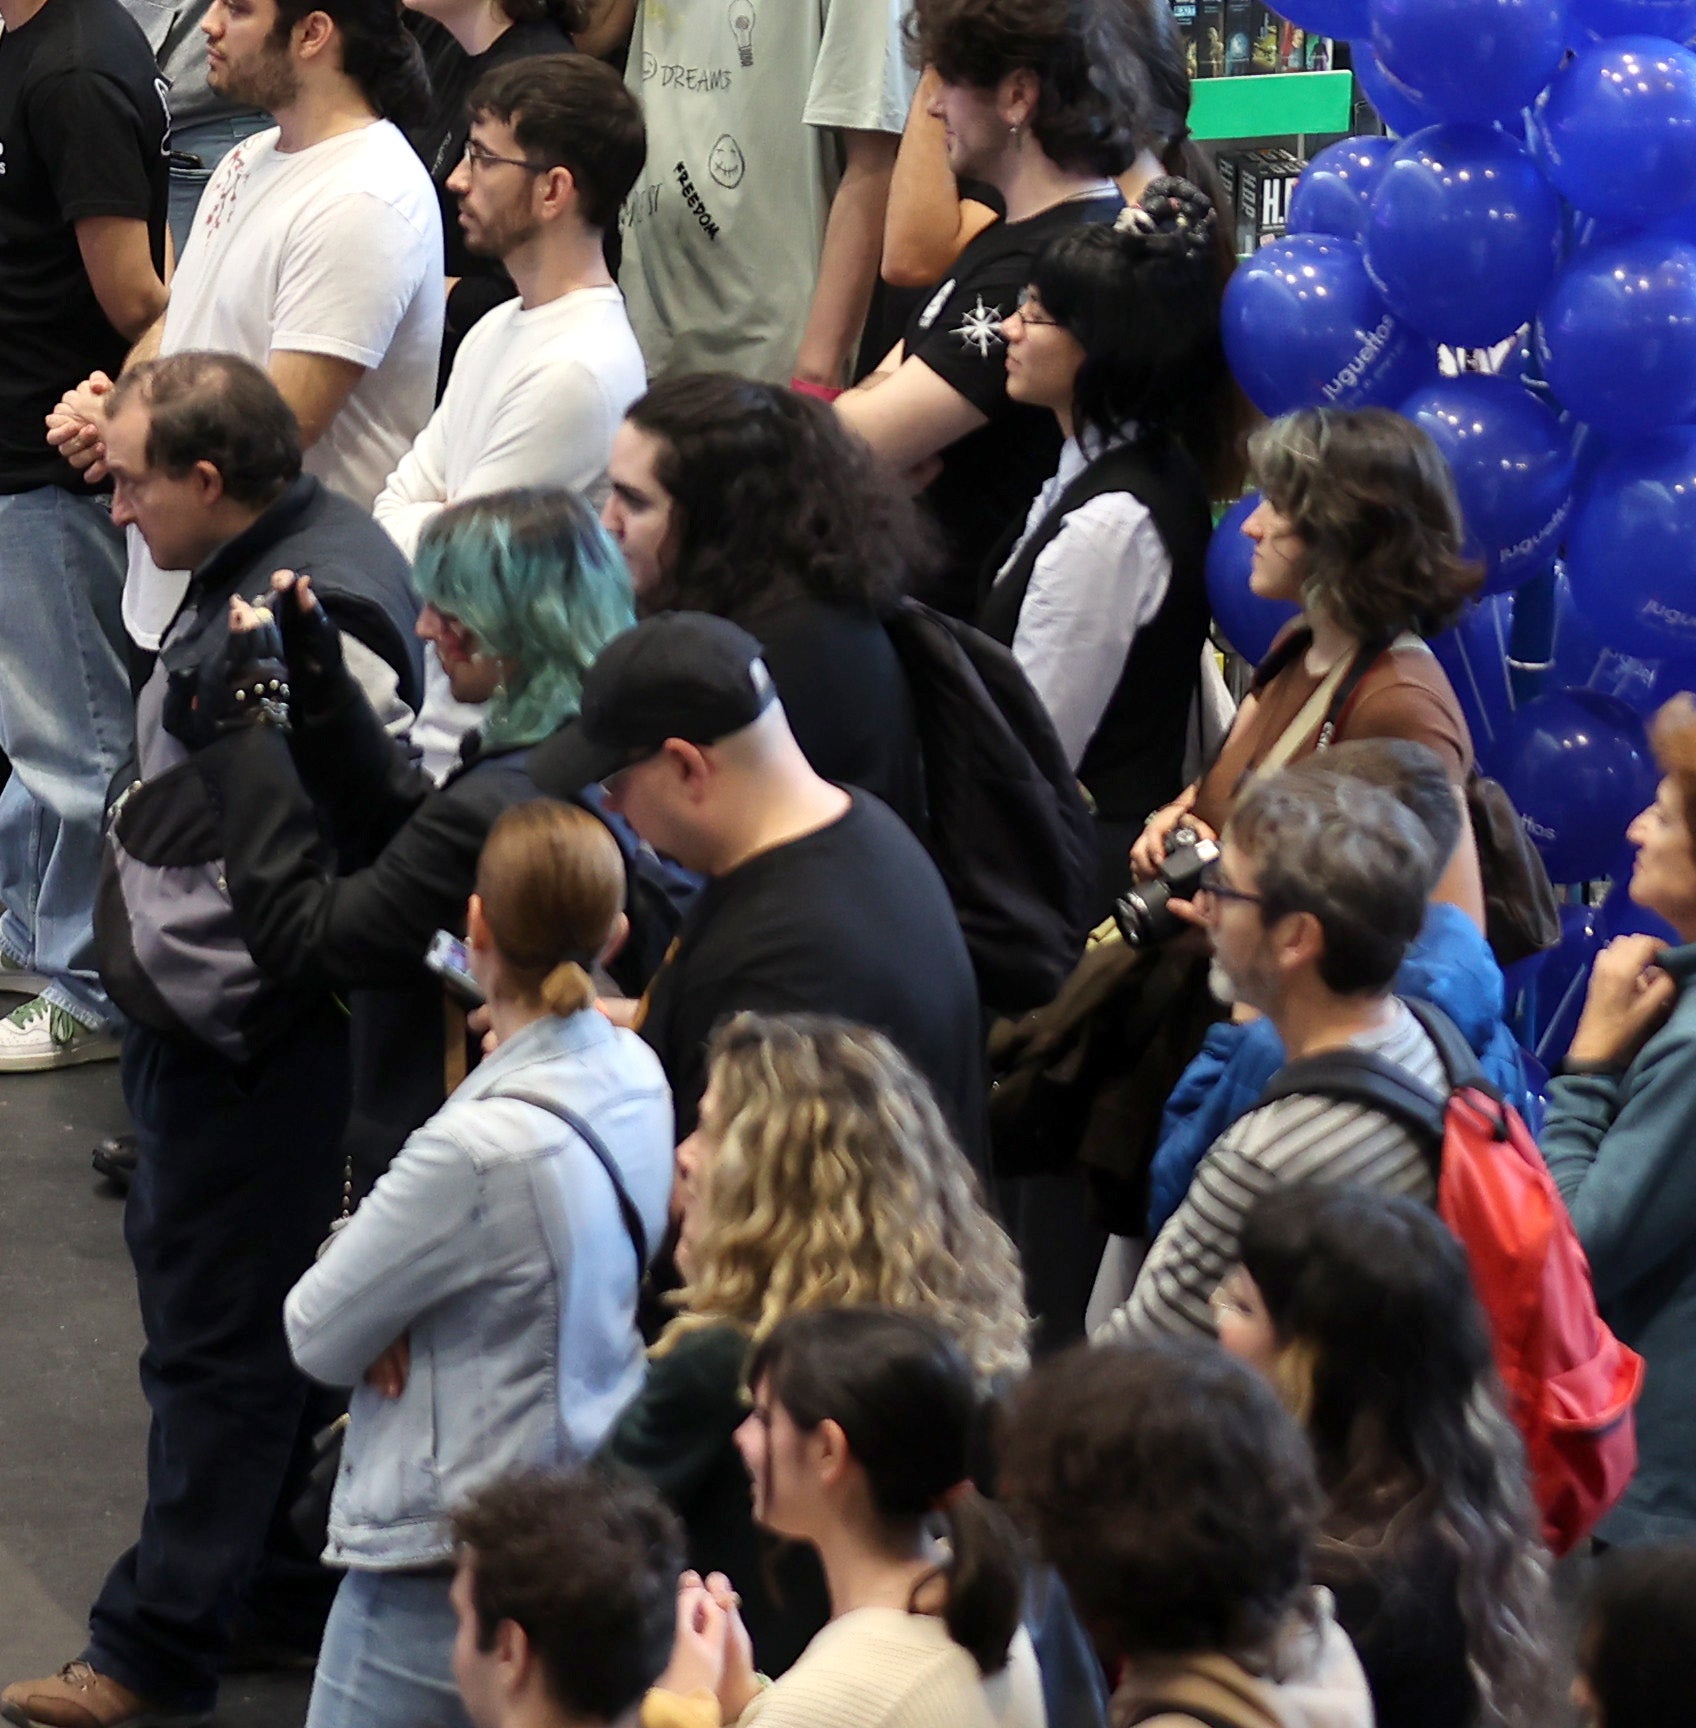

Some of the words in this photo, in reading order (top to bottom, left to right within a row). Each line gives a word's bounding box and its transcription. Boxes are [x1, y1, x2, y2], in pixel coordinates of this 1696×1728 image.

[661, 64, 733, 92] DREAMS
[673, 160, 720, 242] FREEDOM
[1318, 314, 1396, 402] juguettos
